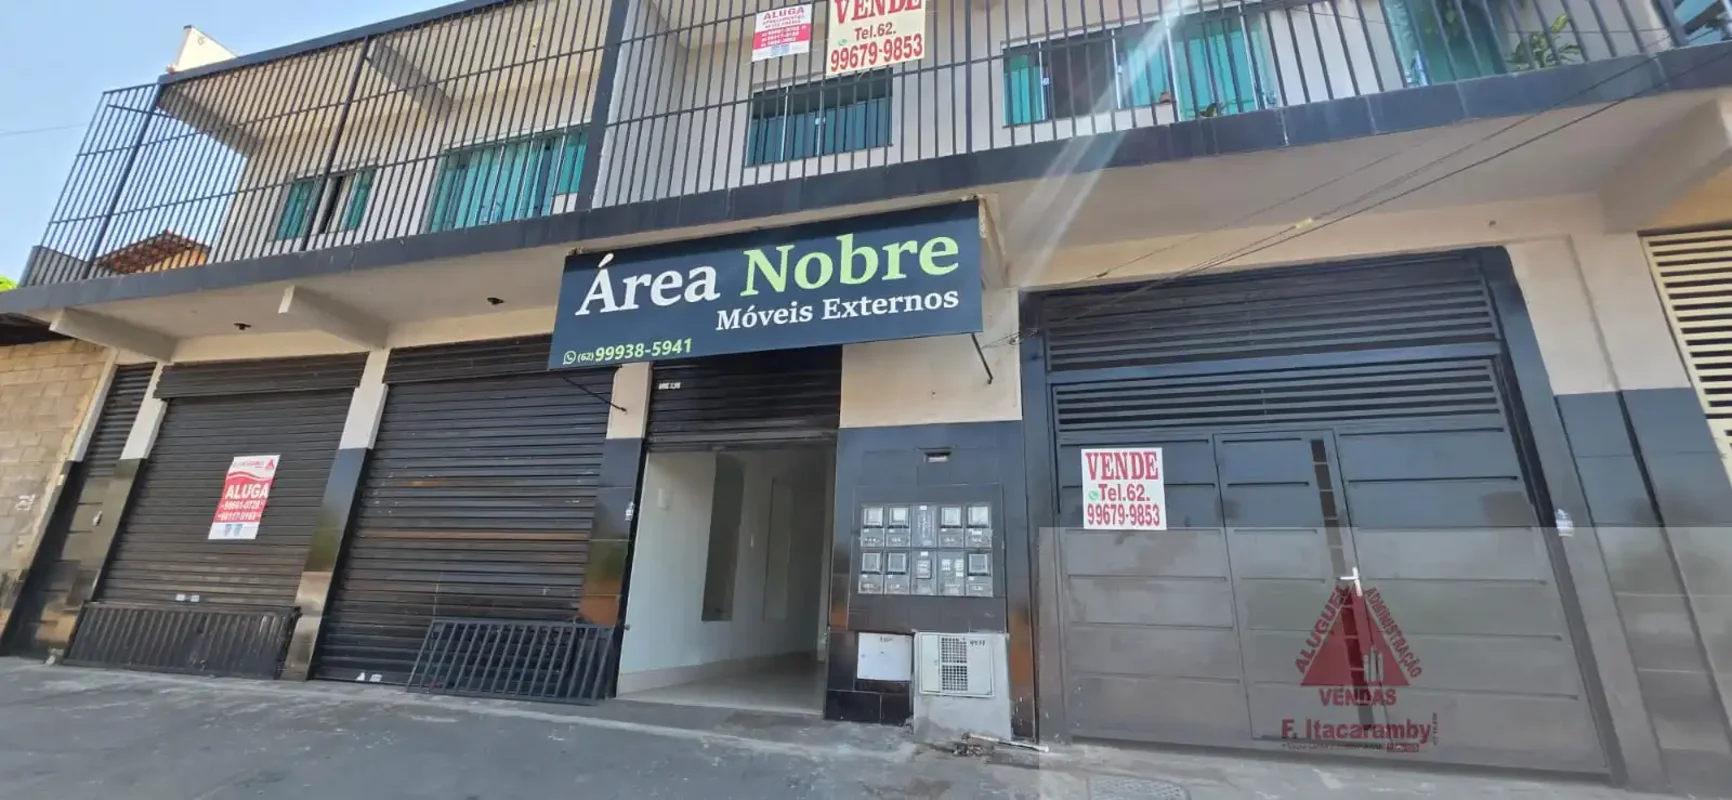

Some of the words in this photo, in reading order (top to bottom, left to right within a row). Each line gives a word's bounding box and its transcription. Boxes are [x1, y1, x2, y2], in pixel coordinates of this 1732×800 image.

[763, 7, 805, 20] ALUGA
[854, 22, 897, 41] Tel.62.
[830, 33, 923, 72] 99679-9853
[575, 253, 720, 316] Área
[740, 232, 959, 297] Nobre
[715, 304, 813, 331] Móveis
[821, 289, 959, 321] Externos
[577, 351, 595, 363] (62)
[595, 337, 693, 362] 99938-5941
[1085, 451, 1159, 480] VENDE
[225, 483, 270, 499] ALUGA
[1098, 483, 1151, 502] Tel.62.
[1087, 503, 1161, 527] 99679-9853
